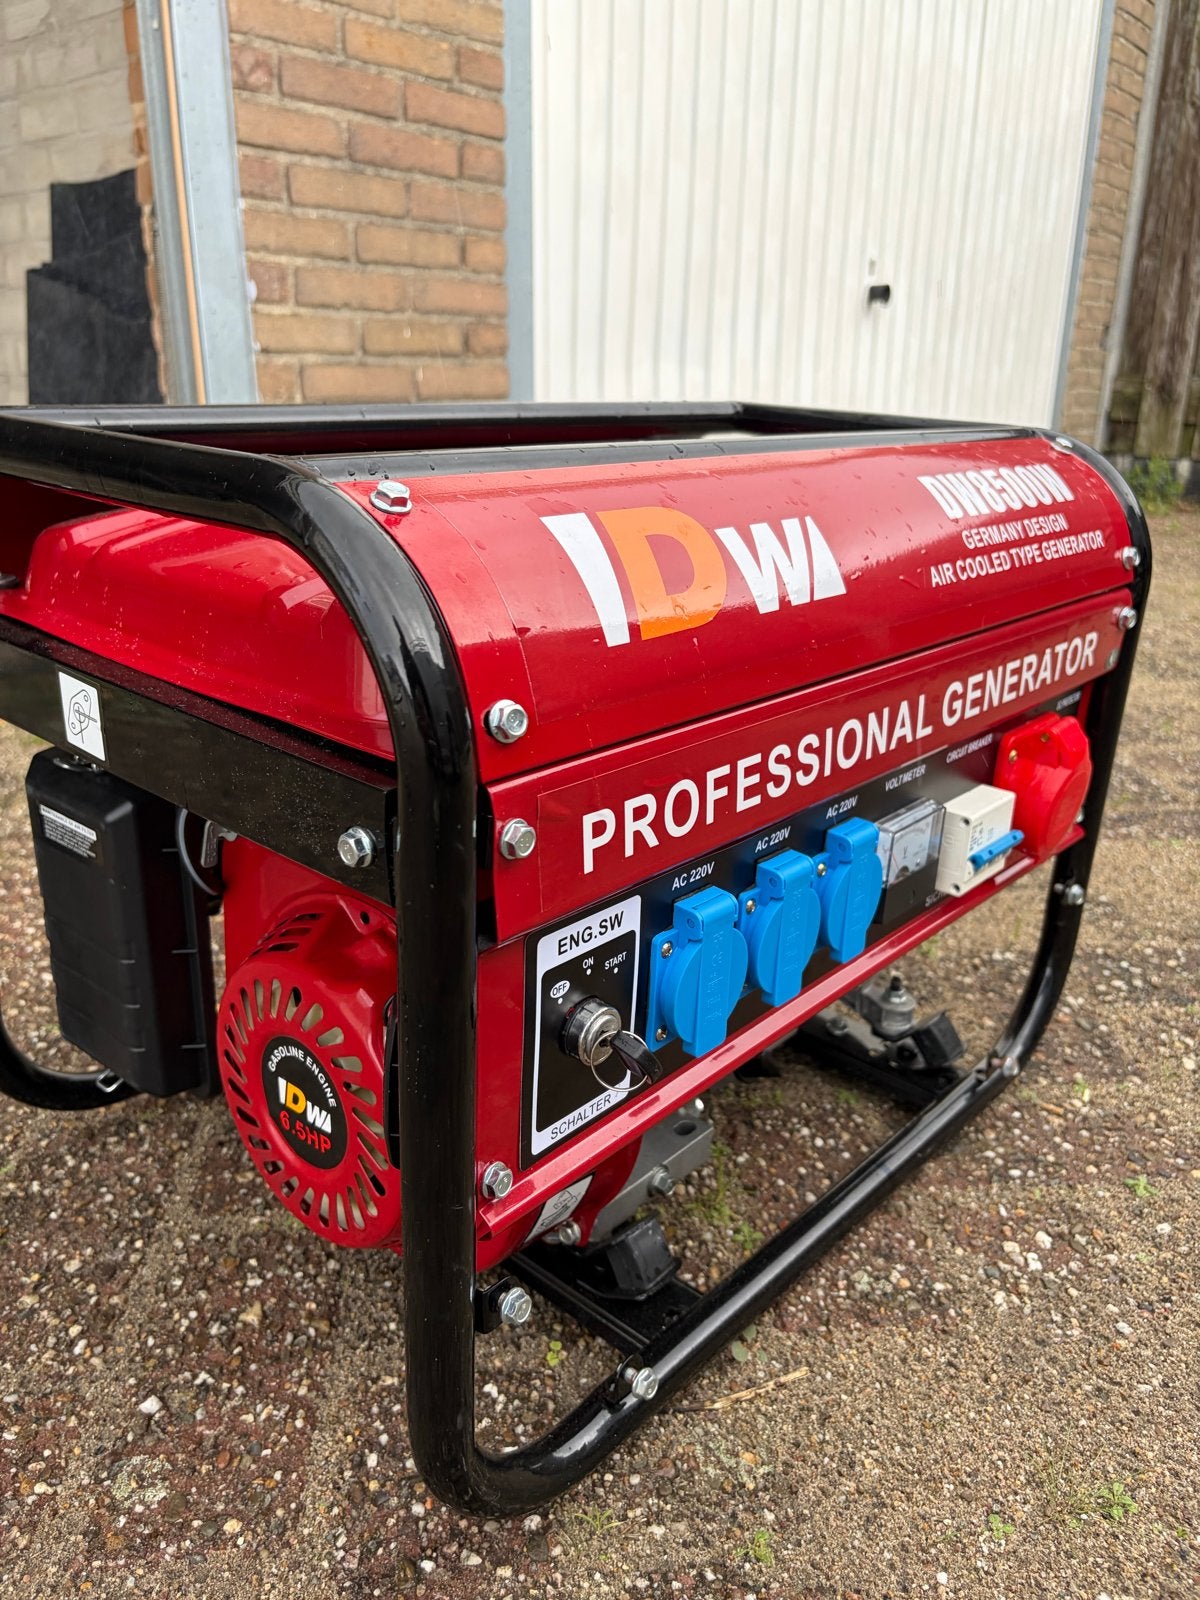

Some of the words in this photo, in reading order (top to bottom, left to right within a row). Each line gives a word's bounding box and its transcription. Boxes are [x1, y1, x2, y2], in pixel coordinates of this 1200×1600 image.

[917, 463, 1075, 520] DW8500W
[961, 520, 1025, 550] GERMANY
[1023, 512, 1069, 539] DESIGN
[930, 562, 955, 588] AIR
[955, 549, 1013, 581] COOLED
[1009, 545, 1043, 569] TYPE
[1041, 529, 1105, 561] GENERATOR
[582, 693, 933, 875] PROFESSIONAL
[942, 631, 1099, 728] GENERATOR
[946, 744, 969, 763] CIRCUIT
[967, 733, 993, 753] BREAKER
[825, 804, 841, 820] AC
[840, 795, 858, 814] 220V
[755, 836, 772, 854] AC
[772, 826, 791, 847] 220V
[671, 872, 691, 891] AC
[691, 861, 716, 883] 220V
[557, 911, 624, 956] ENG.SW
[582, 956, 594, 970] ON
[604, 952, 627, 971] START
[552, 982, 568, 998] OFF
[267, 1045, 305, 1073] GASOLINE
[305, 1055, 337, 1108] ENGINE
[279, 1110, 332, 1153] 6.5HP
[550, 1093, 612, 1140] SCHALTER
